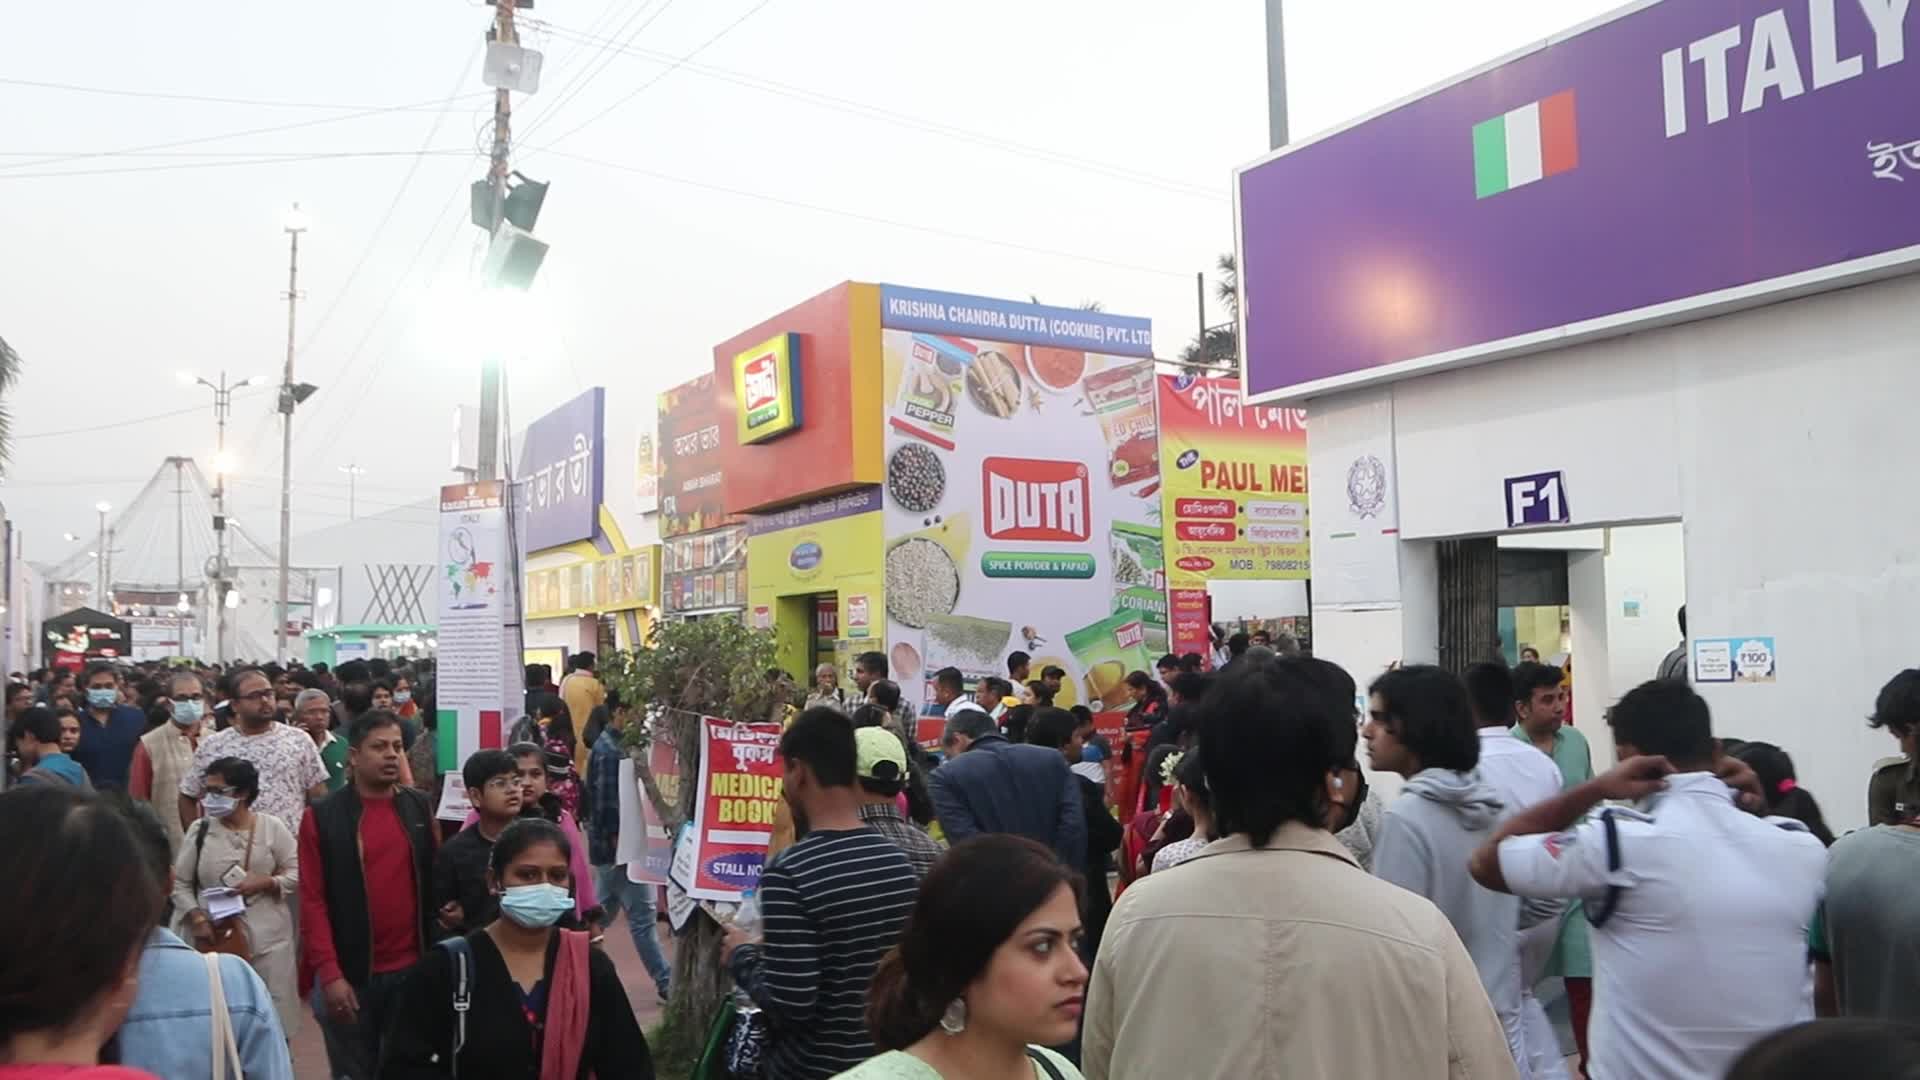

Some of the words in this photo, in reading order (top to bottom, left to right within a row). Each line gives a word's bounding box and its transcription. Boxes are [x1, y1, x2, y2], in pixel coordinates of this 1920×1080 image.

[1662, 0, 1910, 139] ITALY
[889, 298, 946, 321] KRISHNA
[948, 305, 1006, 329] CHANDRA
[1007, 313, 1047, 333] DUTTA
[907, 404, 953, 425] PEPPER
[1200, 460, 1263, 491] PAUL
[990, 470, 1085, 538] DUTA
[1512, 477, 1561, 524] F1
[719, 799, 777, 824] BOOK
[713, 862, 745, 876] STALL
